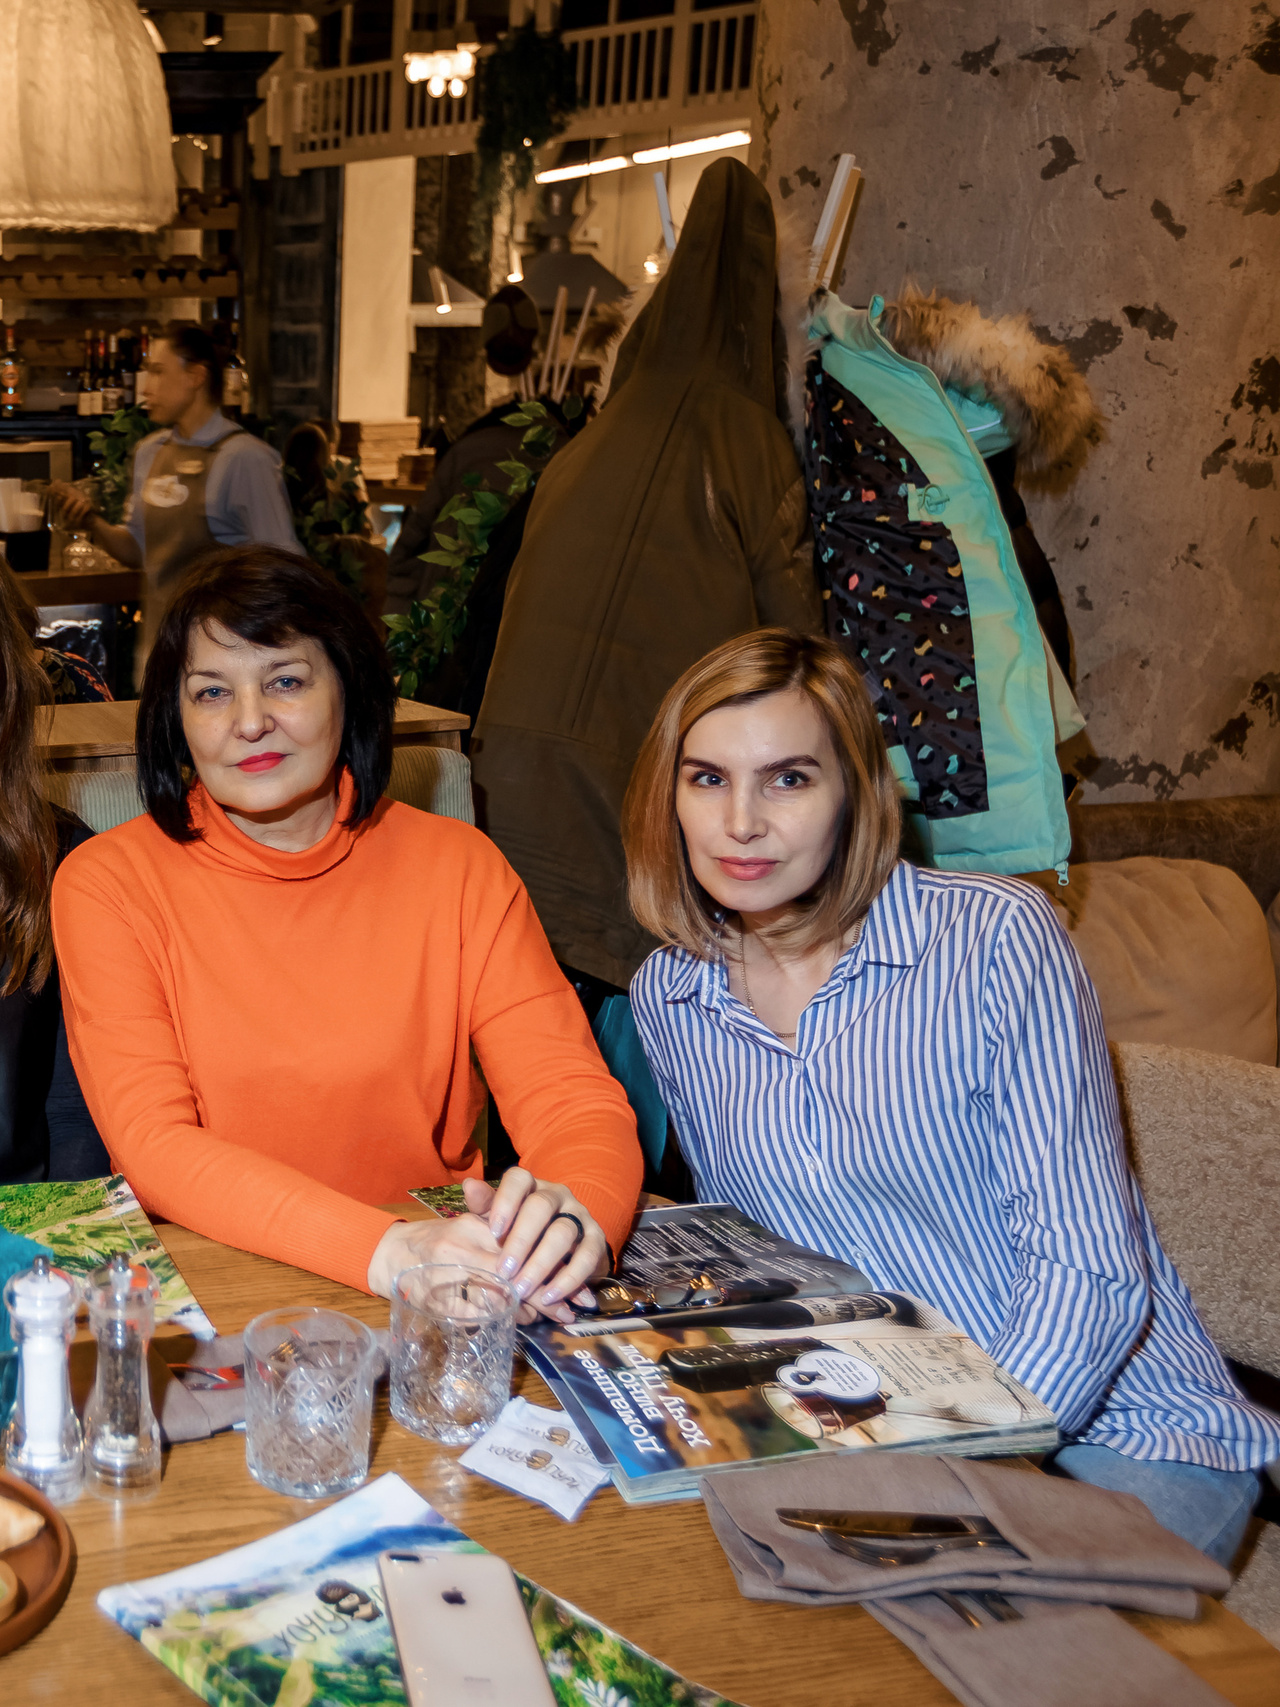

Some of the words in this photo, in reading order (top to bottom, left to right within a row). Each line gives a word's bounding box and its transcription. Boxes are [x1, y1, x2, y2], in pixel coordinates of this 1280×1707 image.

[617, 1343, 669, 1390] Пури
[573, 1349, 666, 1454] Домашнее
[616, 1371, 665, 1420] вино
[657, 1394, 712, 1448] Хочу
[272, 1604, 349, 1652] ХОЧУ
